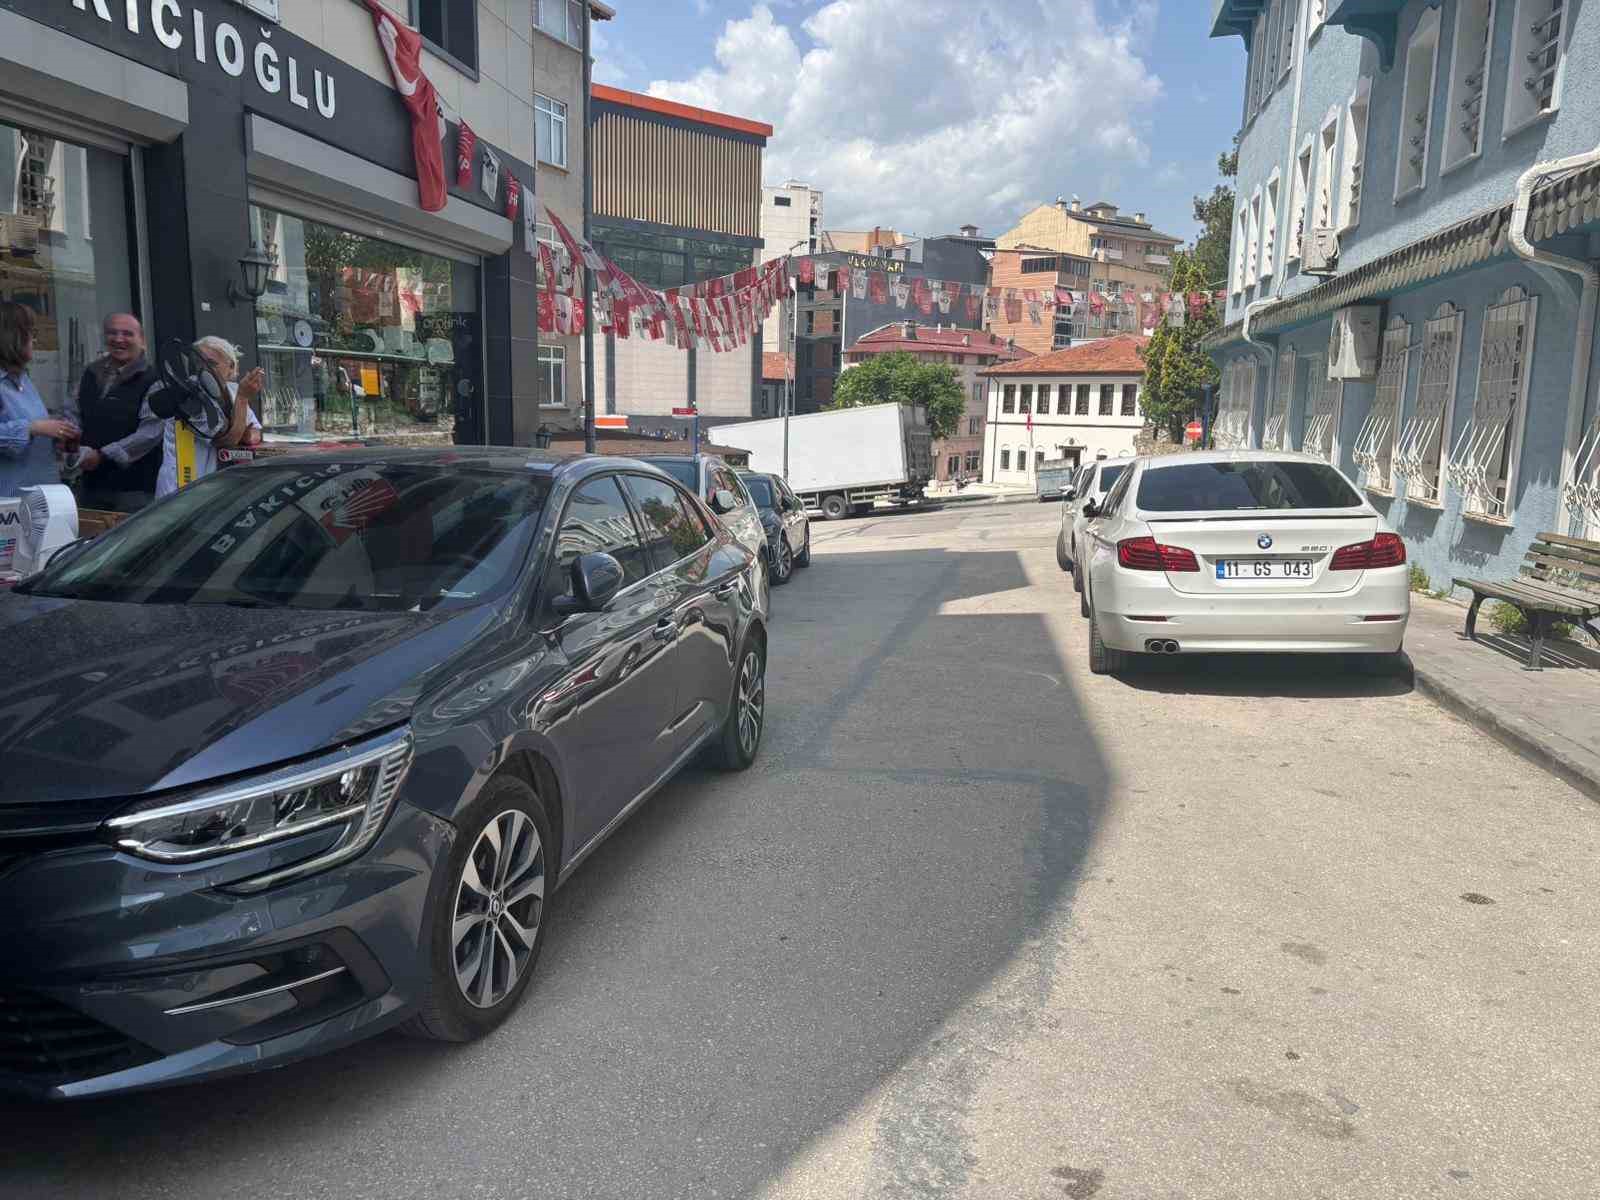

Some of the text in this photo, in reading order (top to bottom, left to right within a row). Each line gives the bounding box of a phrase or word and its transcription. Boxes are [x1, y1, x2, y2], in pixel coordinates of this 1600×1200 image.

[1226, 561, 1311, 576] 11 GS 043
